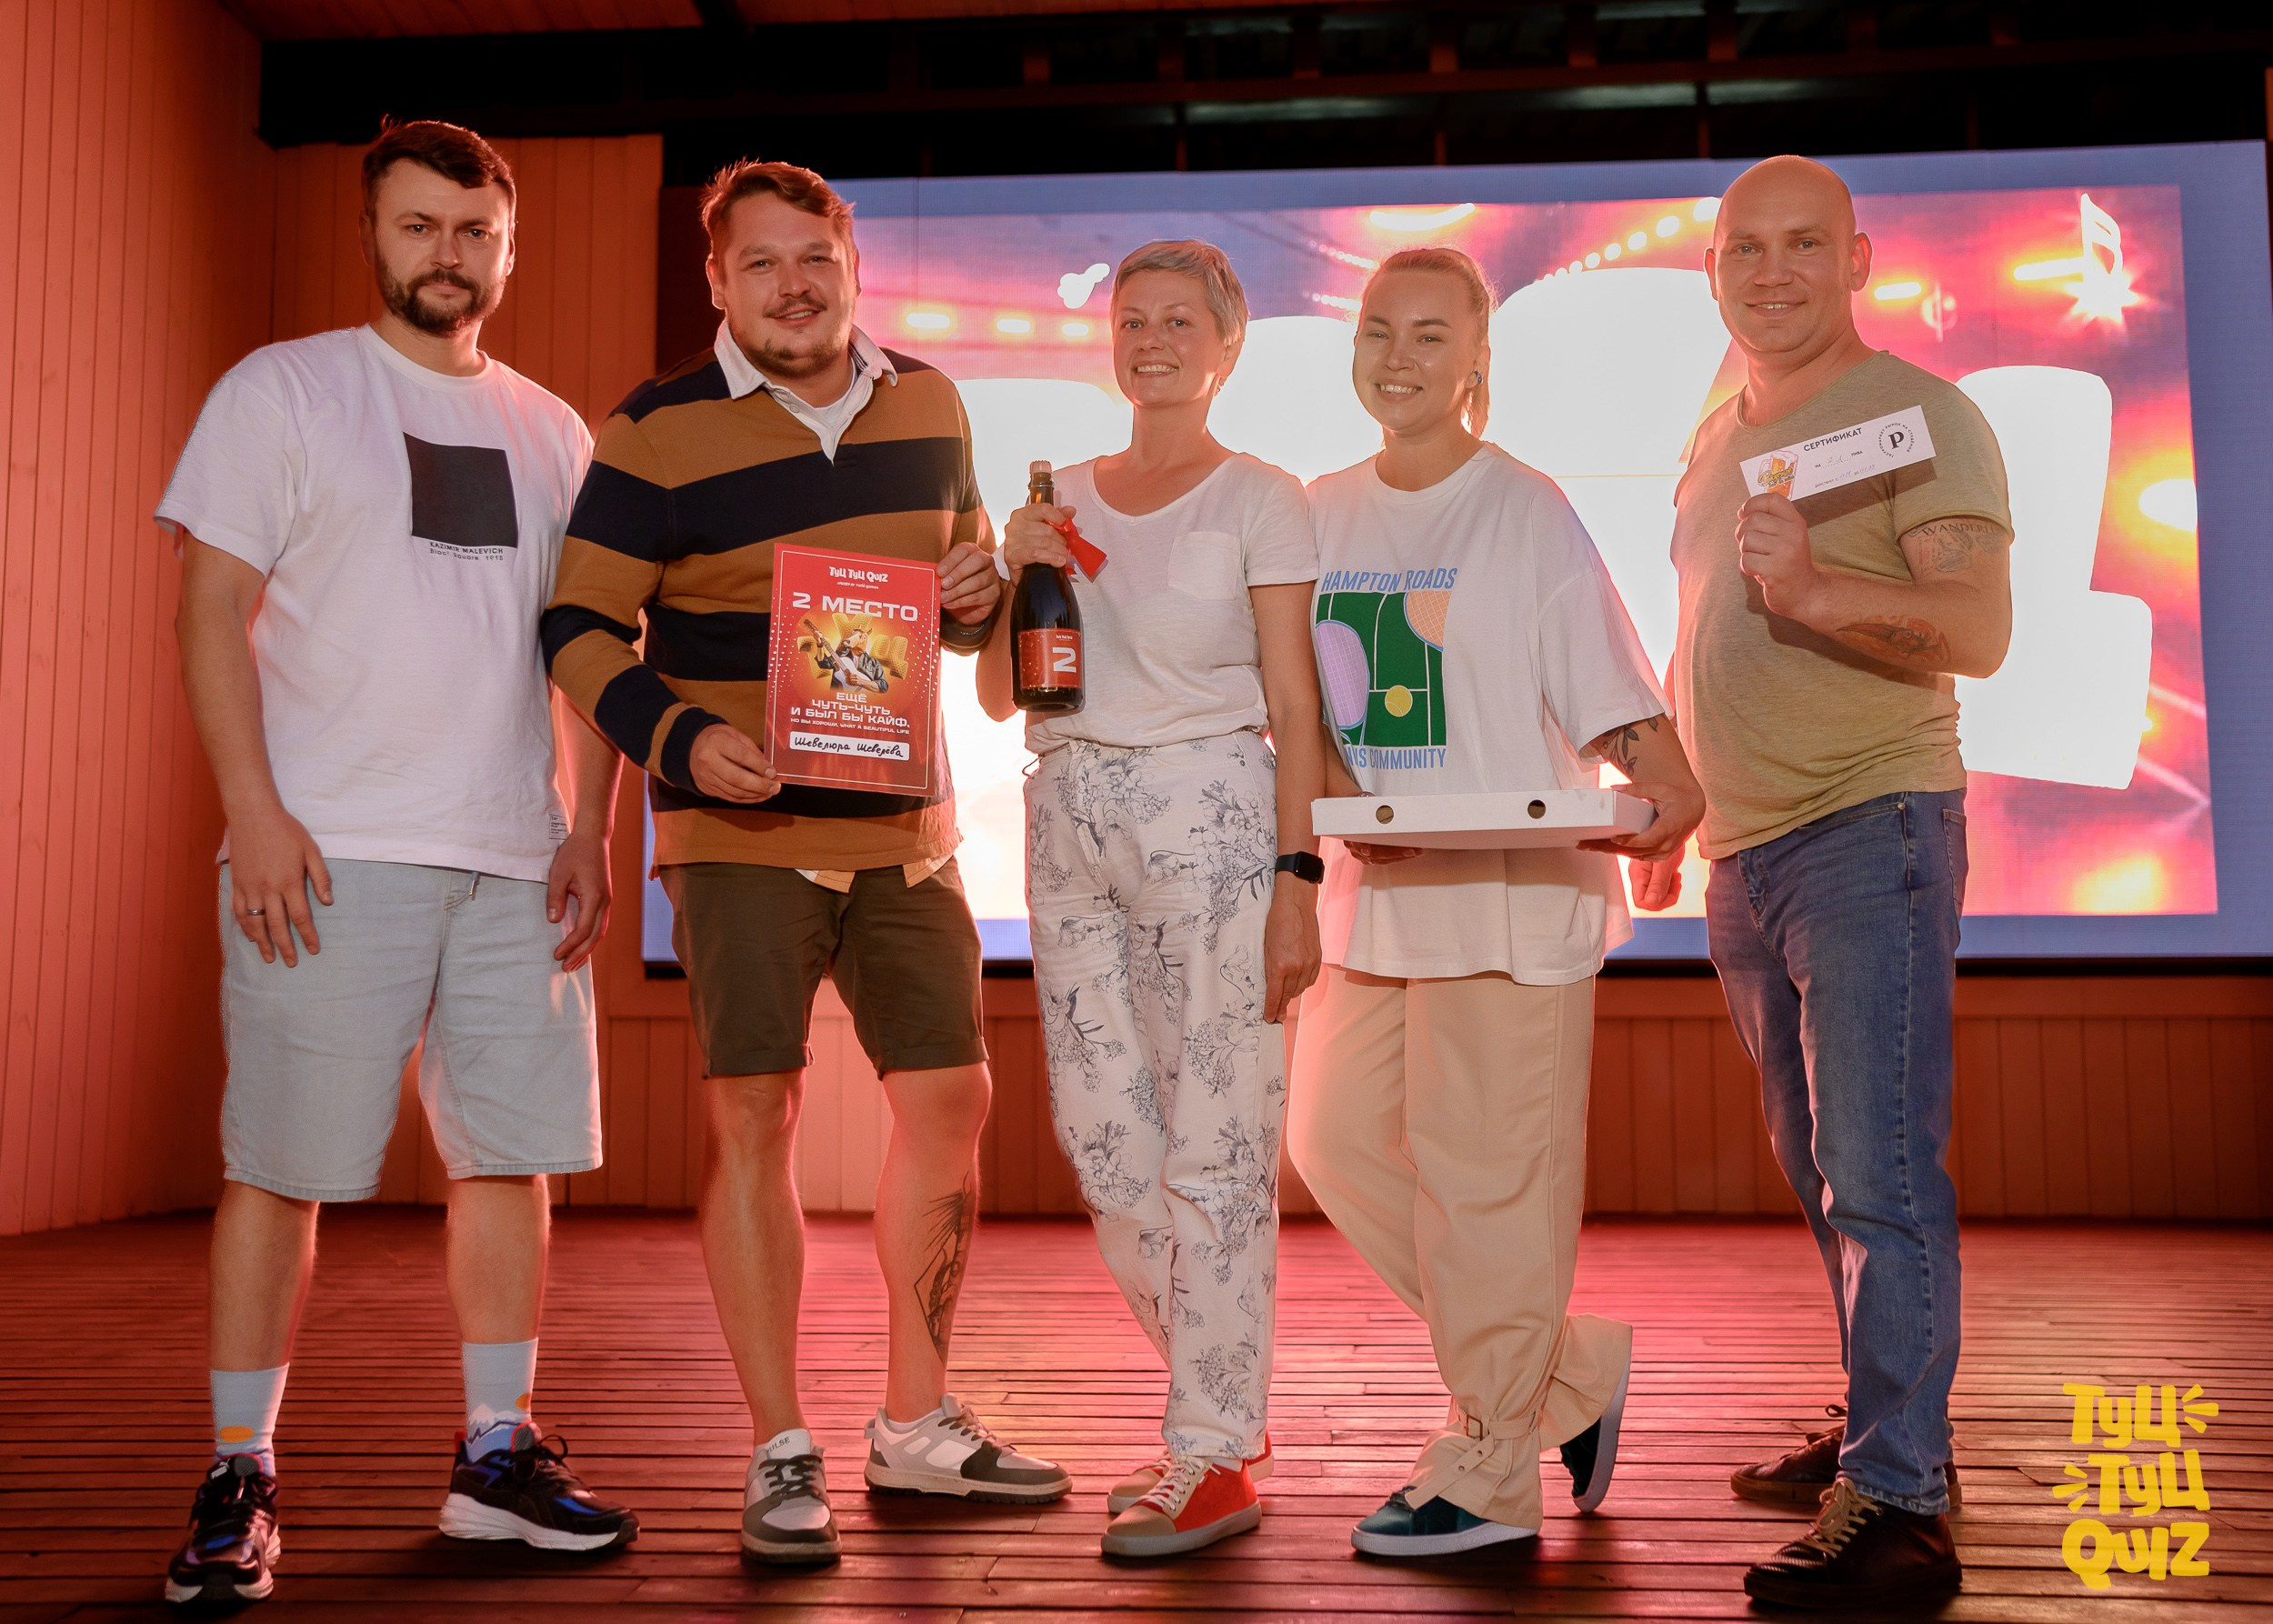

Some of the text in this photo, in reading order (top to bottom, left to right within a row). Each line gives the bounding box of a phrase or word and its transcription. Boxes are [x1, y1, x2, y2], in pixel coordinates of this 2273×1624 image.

[1803, 427, 1863, 452] СЕРТИФИКАТ
[429, 541, 460, 553] KAZIMIR
[454, 553, 479, 561] Square
[1321, 567, 1458, 593] HAMPTON ROADS
[792, 591, 918, 622] 2 МЕСТО
[1052, 647, 1077, 673] 2
[836, 692, 867, 703] ЕЩЁ
[790, 707, 801, 716] И
[805, 708, 837, 719] БЫЛ
[841, 712, 864, 722] БЫ
[811, 699, 891, 716] ЧУТЬ-ЧУТЬ
[863, 726, 896, 734] BEAUTIFUL
[794, 737, 851, 753] Шевелюра
[1369, 747, 1447, 770] COMMUNITY
